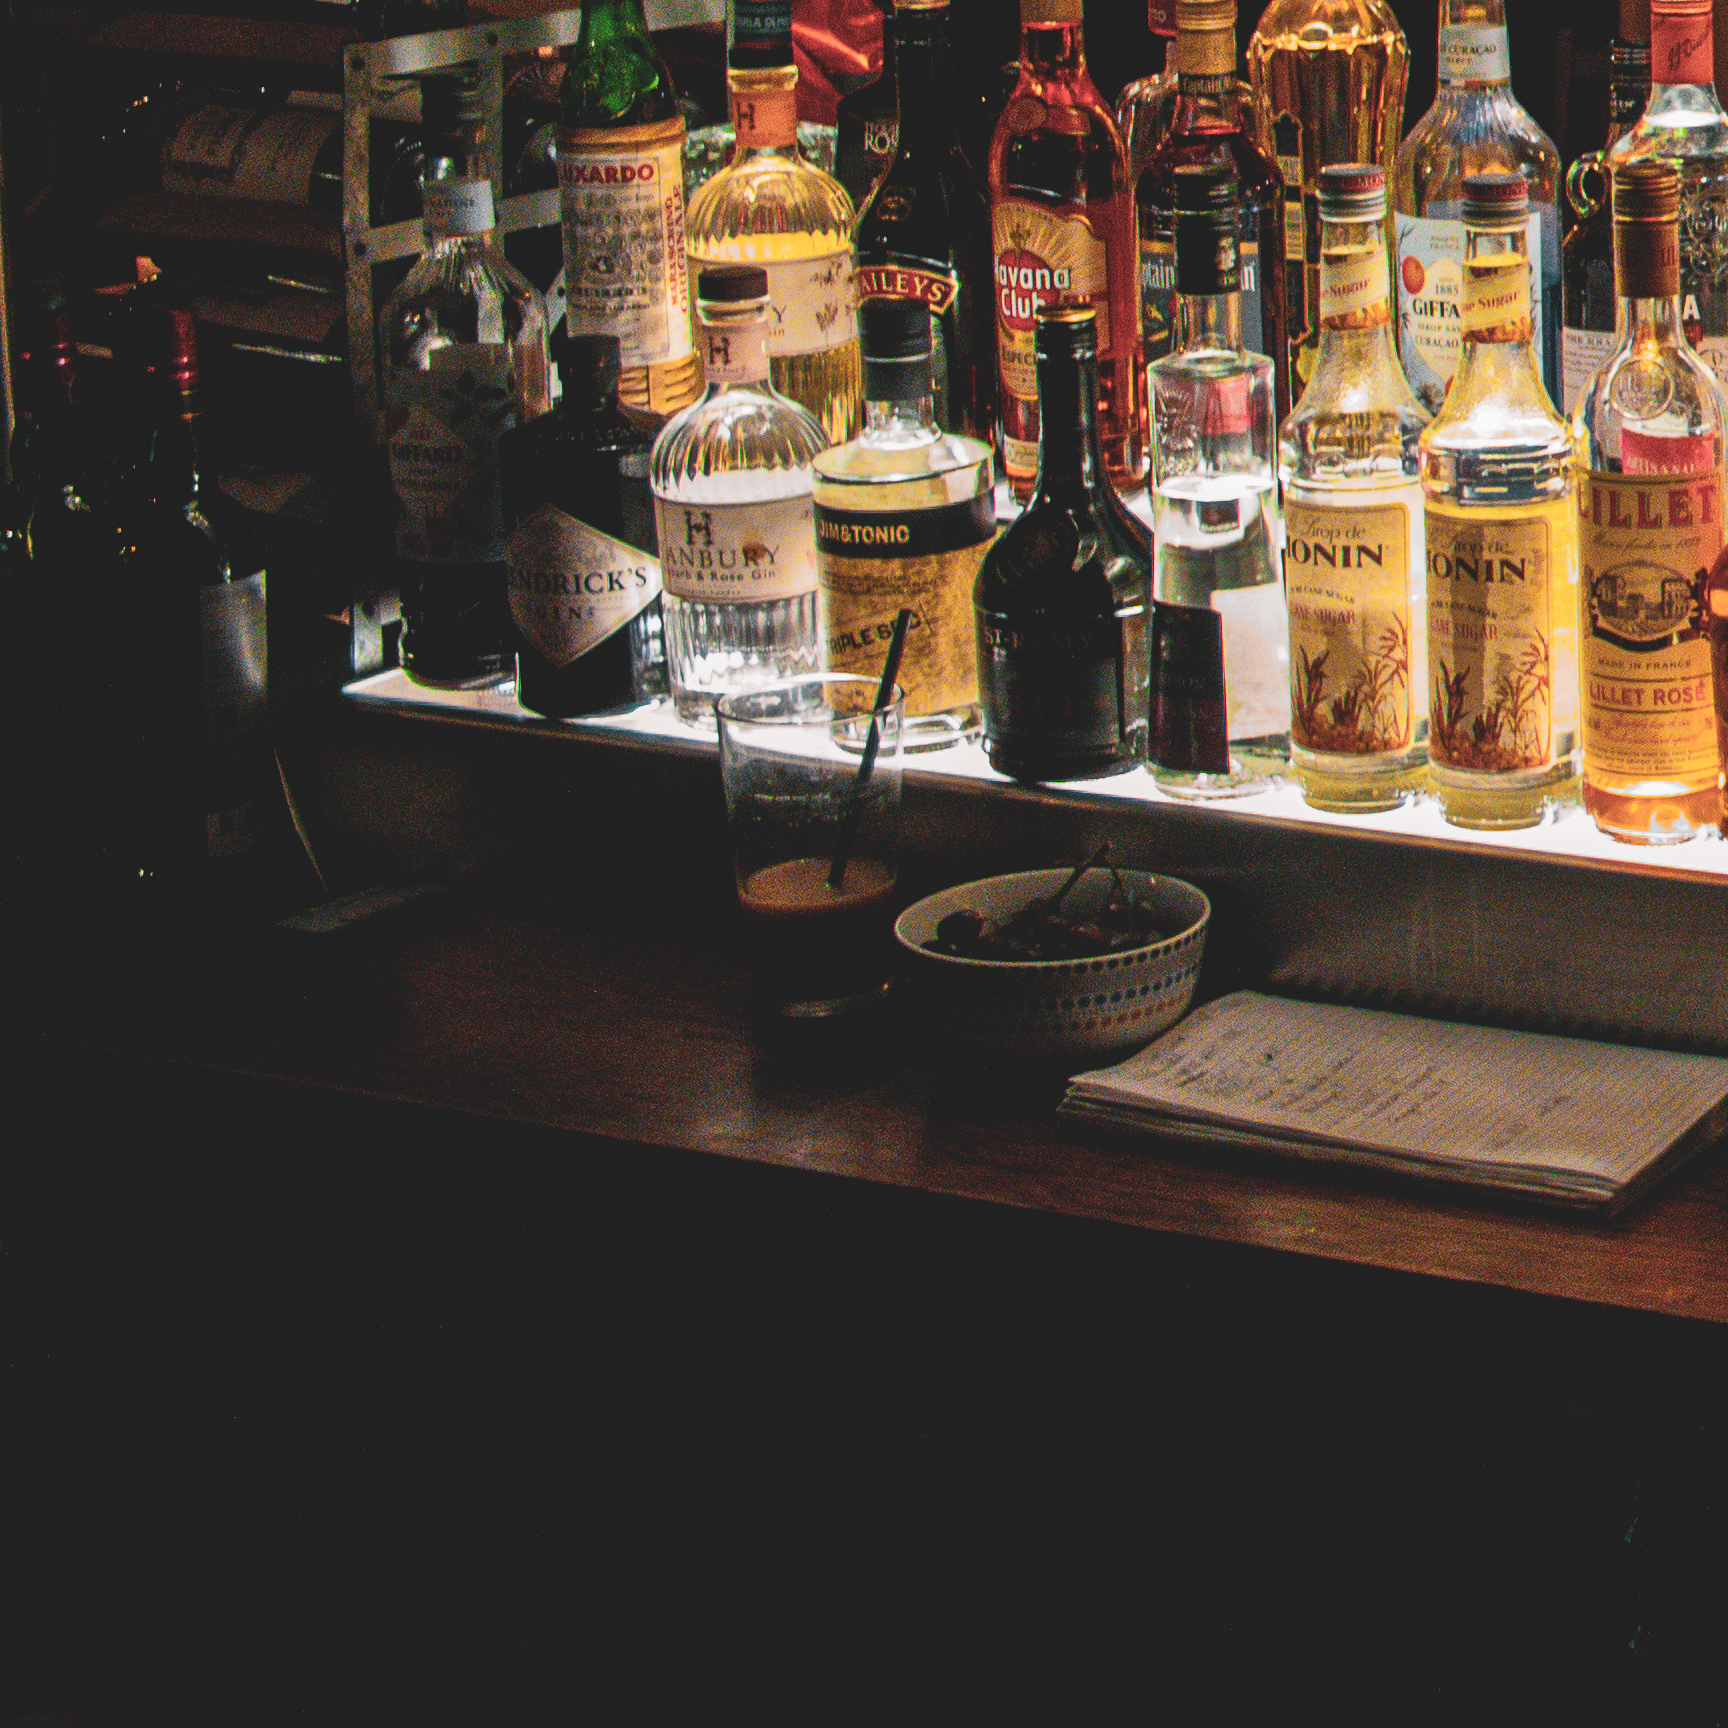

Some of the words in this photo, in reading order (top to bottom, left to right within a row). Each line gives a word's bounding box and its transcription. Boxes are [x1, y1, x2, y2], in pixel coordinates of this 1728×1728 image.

[735, 101, 755, 131] H
[565, 163, 654, 184] UXARDO
[664, 196, 679, 306] MARASCHINO
[672, 184, 689, 315] ORIGINALE
[860, 270, 946, 303] AILEYS
[707, 336, 730, 365] H
[1578, 480, 1717, 528] LILLET
[683, 509, 714, 546] H
[665, 544, 780, 569] ANBURY
[519, 564, 647, 595] NDRICK'S
[750, 568, 777, 580] Gin
[1588, 680, 1646, 706] LILLET
[1652, 678, 1706, 707] ROSÉ
